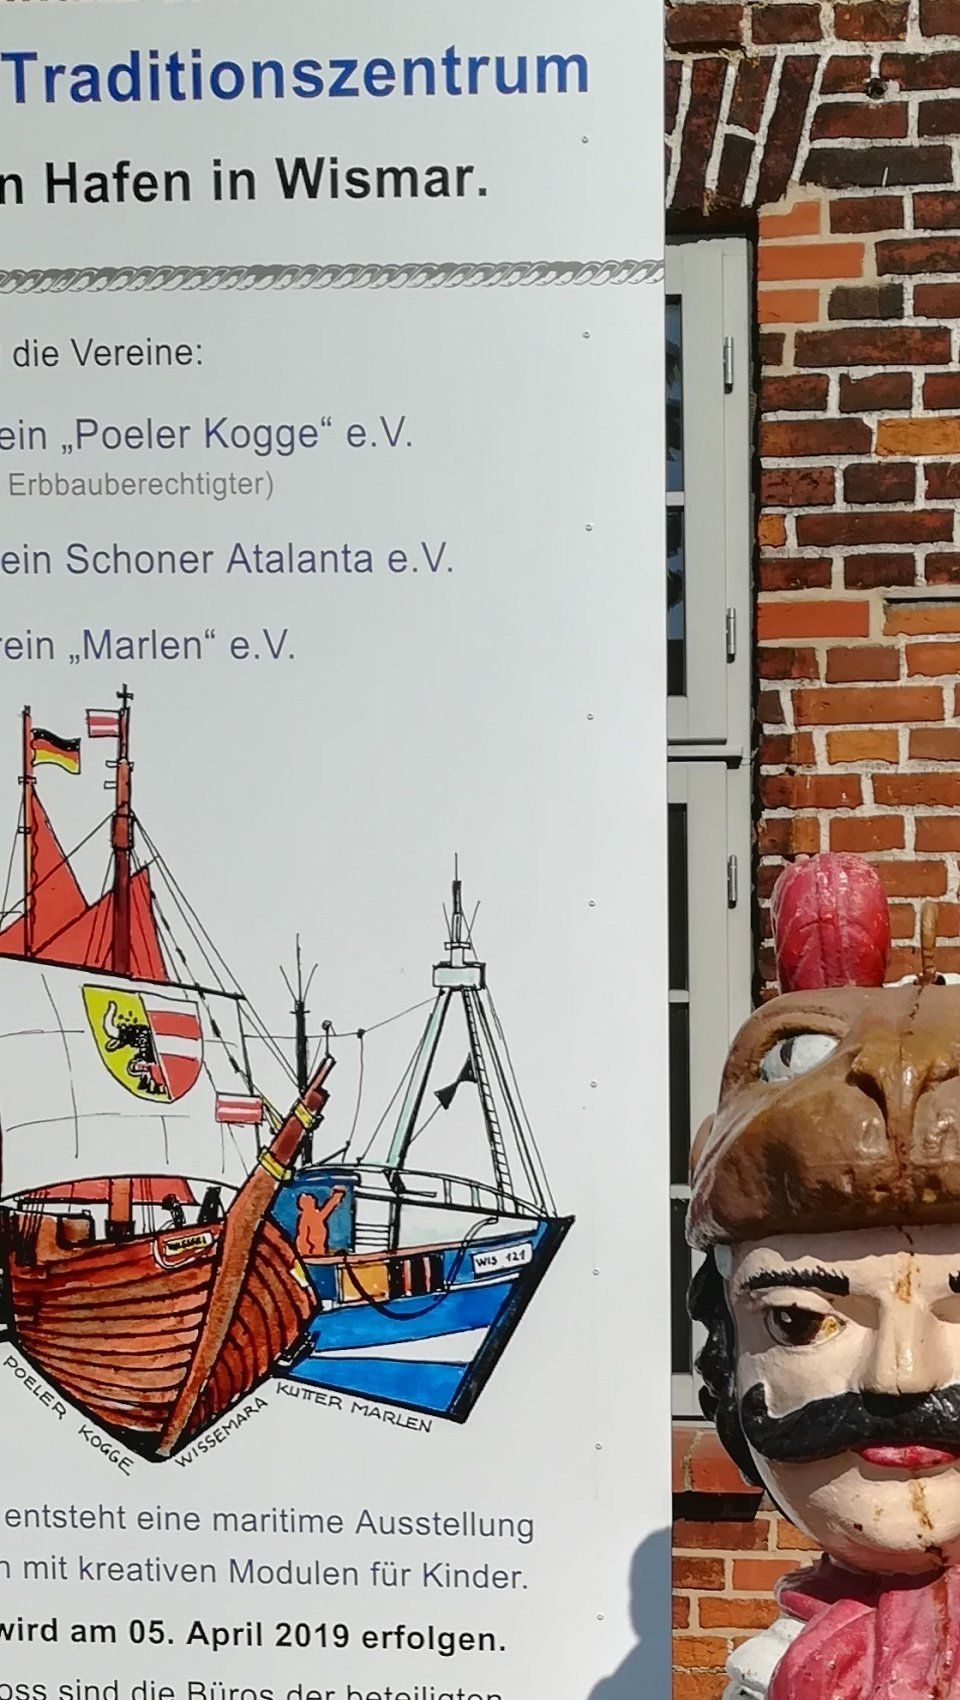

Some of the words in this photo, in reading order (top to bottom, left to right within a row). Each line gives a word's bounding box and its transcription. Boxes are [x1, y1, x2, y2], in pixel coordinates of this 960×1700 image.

[1, 44, 588, 104] Traditionszentrum
[45, 159, 191, 204] Hafen
[212, 158, 256, 201] in
[274, 156, 487, 200] Wismar.
[12, 338, 60, 368] die
[70, 337, 202, 367] Vereine:
[346, 415, 412, 448] e.V.
[8, 470, 274, 502] Erbbauberechtigter)
[66, 542, 215, 575] Schoner
[226, 541, 374, 574] Atalanta
[387, 541, 453, 574] e.V.
[0, 629, 55, 660] ein
[230, 628, 295, 660] e.V.
[475, 1256, 498, 1267] WIS
[3, 1355, 67, 1420] POELER
[78, 1424, 134, 1477] KOGGE
[276, 1381, 343, 1410] KUTTER
[350, 1401, 433, 1433] MARLEN
[174, 1397, 268, 1468] WISSEMARA
[4, 1503, 127, 1530] entsteht
[137, 1511, 201, 1532] eine
[213, 1507, 344, 1534] maritime
[354, 1508, 534, 1545] Ausstellung
[23, 1554, 68, 1581] mit
[78, 1555, 217, 1583] kreativen
[229, 1558, 359, 1586] Modulen
[369, 1560, 412, 1587] für
[423, 1562, 528, 1590] Kinder.
[0, 1616, 58, 1643] wird
[70, 1624, 117, 1644] am
[129, 1619, 174, 1645] 05.
[185, 1620, 263, 1652] April
[275, 1622, 349, 1649] 2019
[361, 1624, 506, 1657] erfolgen.
